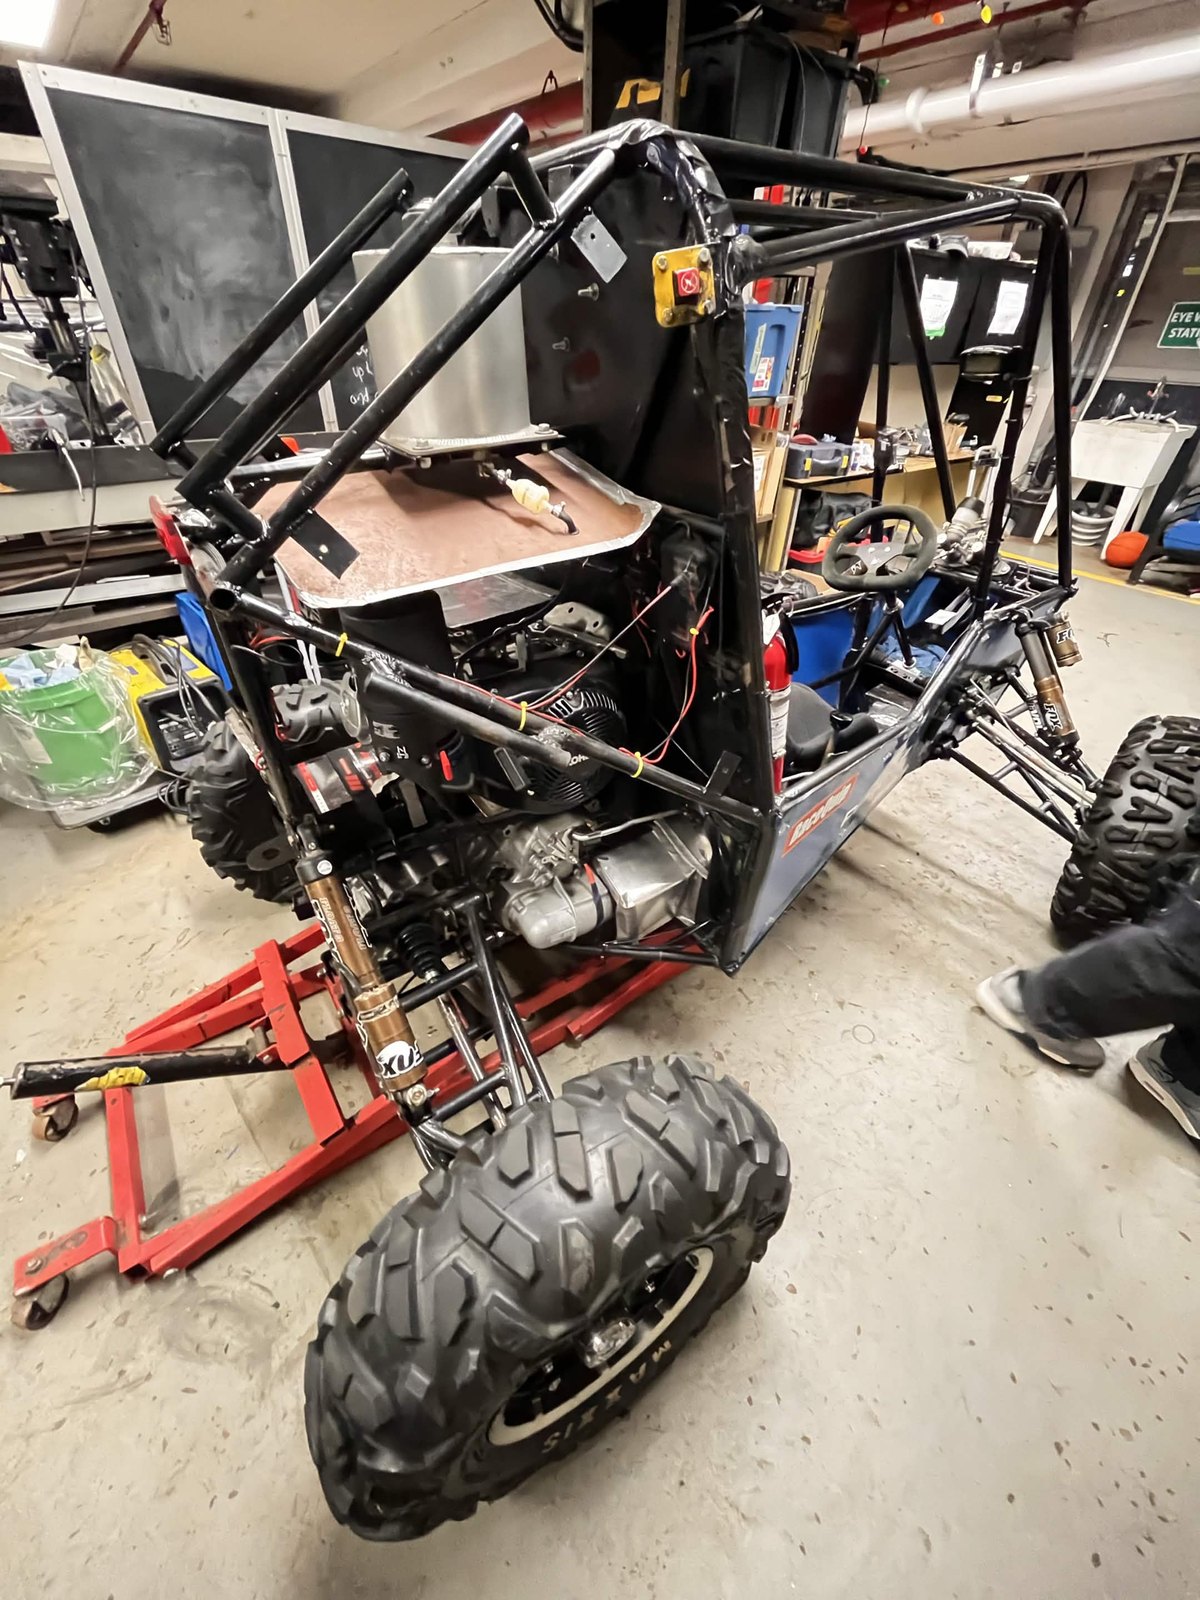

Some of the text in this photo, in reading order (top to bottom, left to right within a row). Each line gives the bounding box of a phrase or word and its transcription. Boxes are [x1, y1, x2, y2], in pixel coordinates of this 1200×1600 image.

[1171, 311, 1195, 323] EYE
[1168, 327, 1200, 338] STATI
[1043, 703, 1063, 732] FOX
[541, 1340, 672, 1454] MAXXIS
